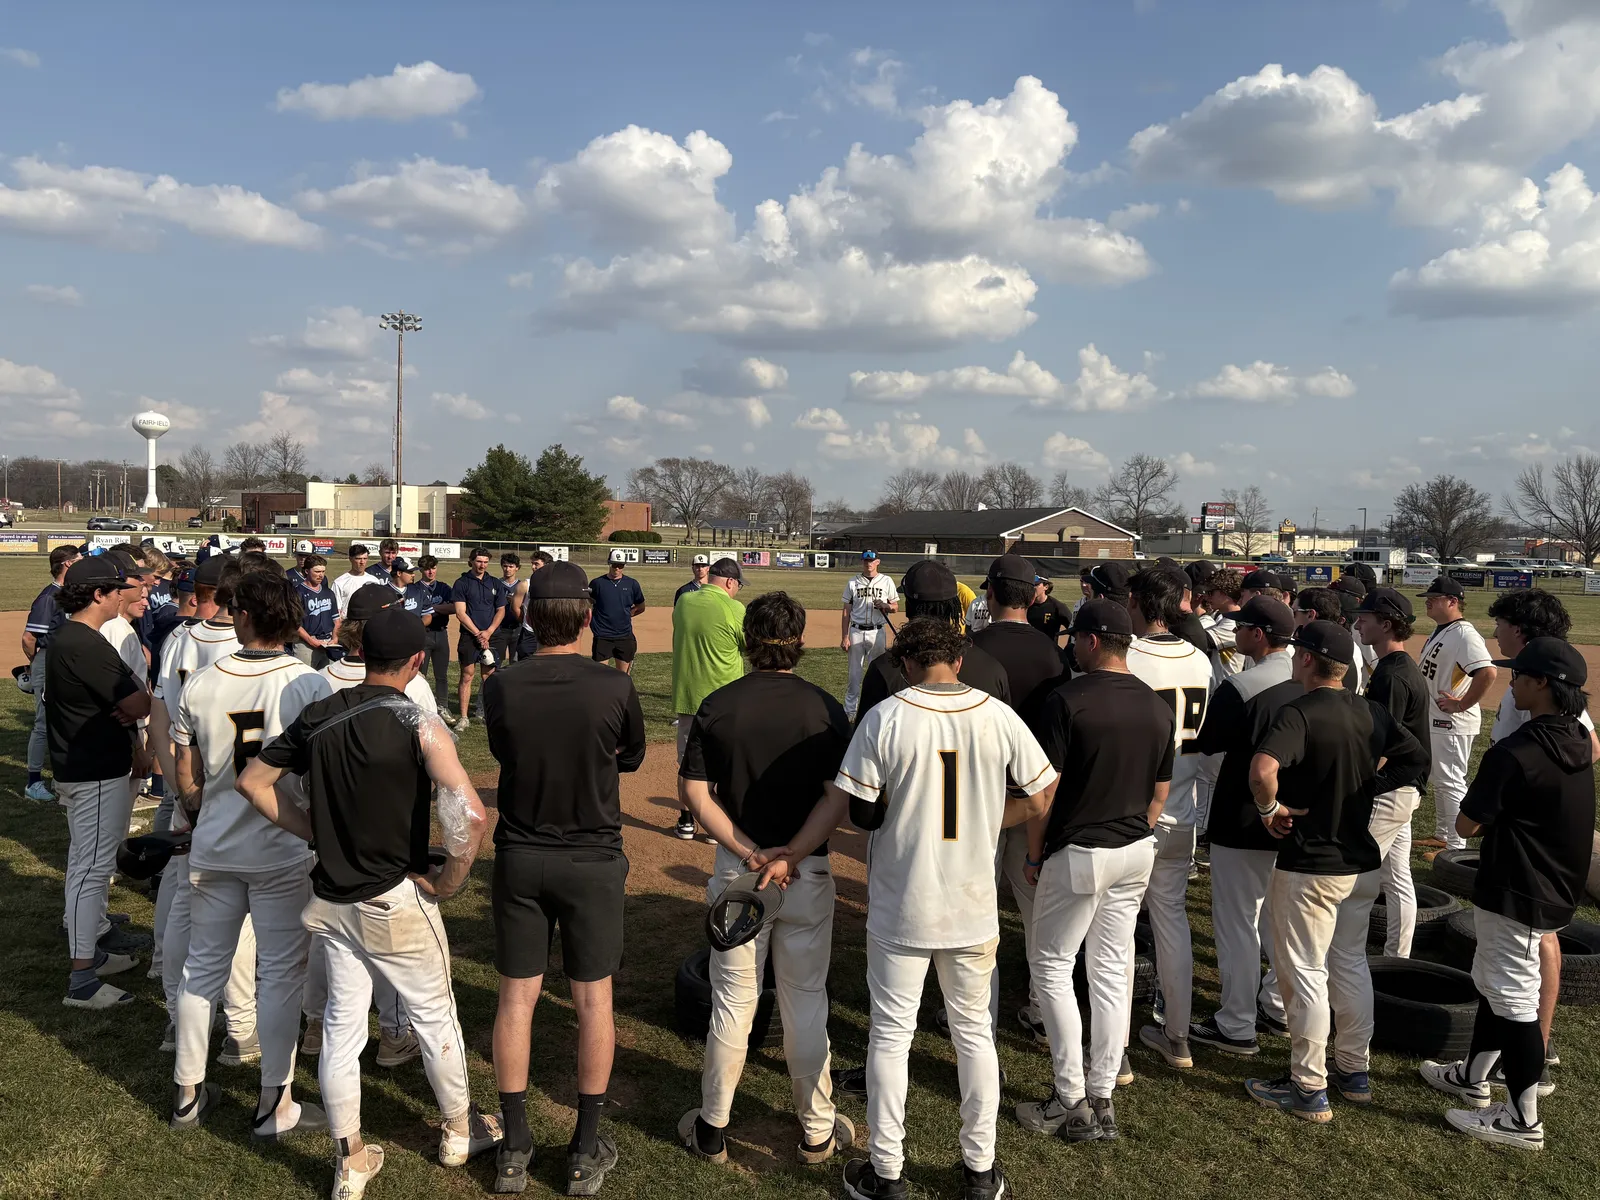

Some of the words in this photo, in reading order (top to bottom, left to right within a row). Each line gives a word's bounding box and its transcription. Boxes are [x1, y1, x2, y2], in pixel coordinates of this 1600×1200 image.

[138, 419, 168, 427] FAIRFIELD
[857, 587, 882, 598] BOBCATS
[308, 597, 331, 611] Olney
[1421, 659, 1438, 680] 35
[937, 749, 959, 841] 1
